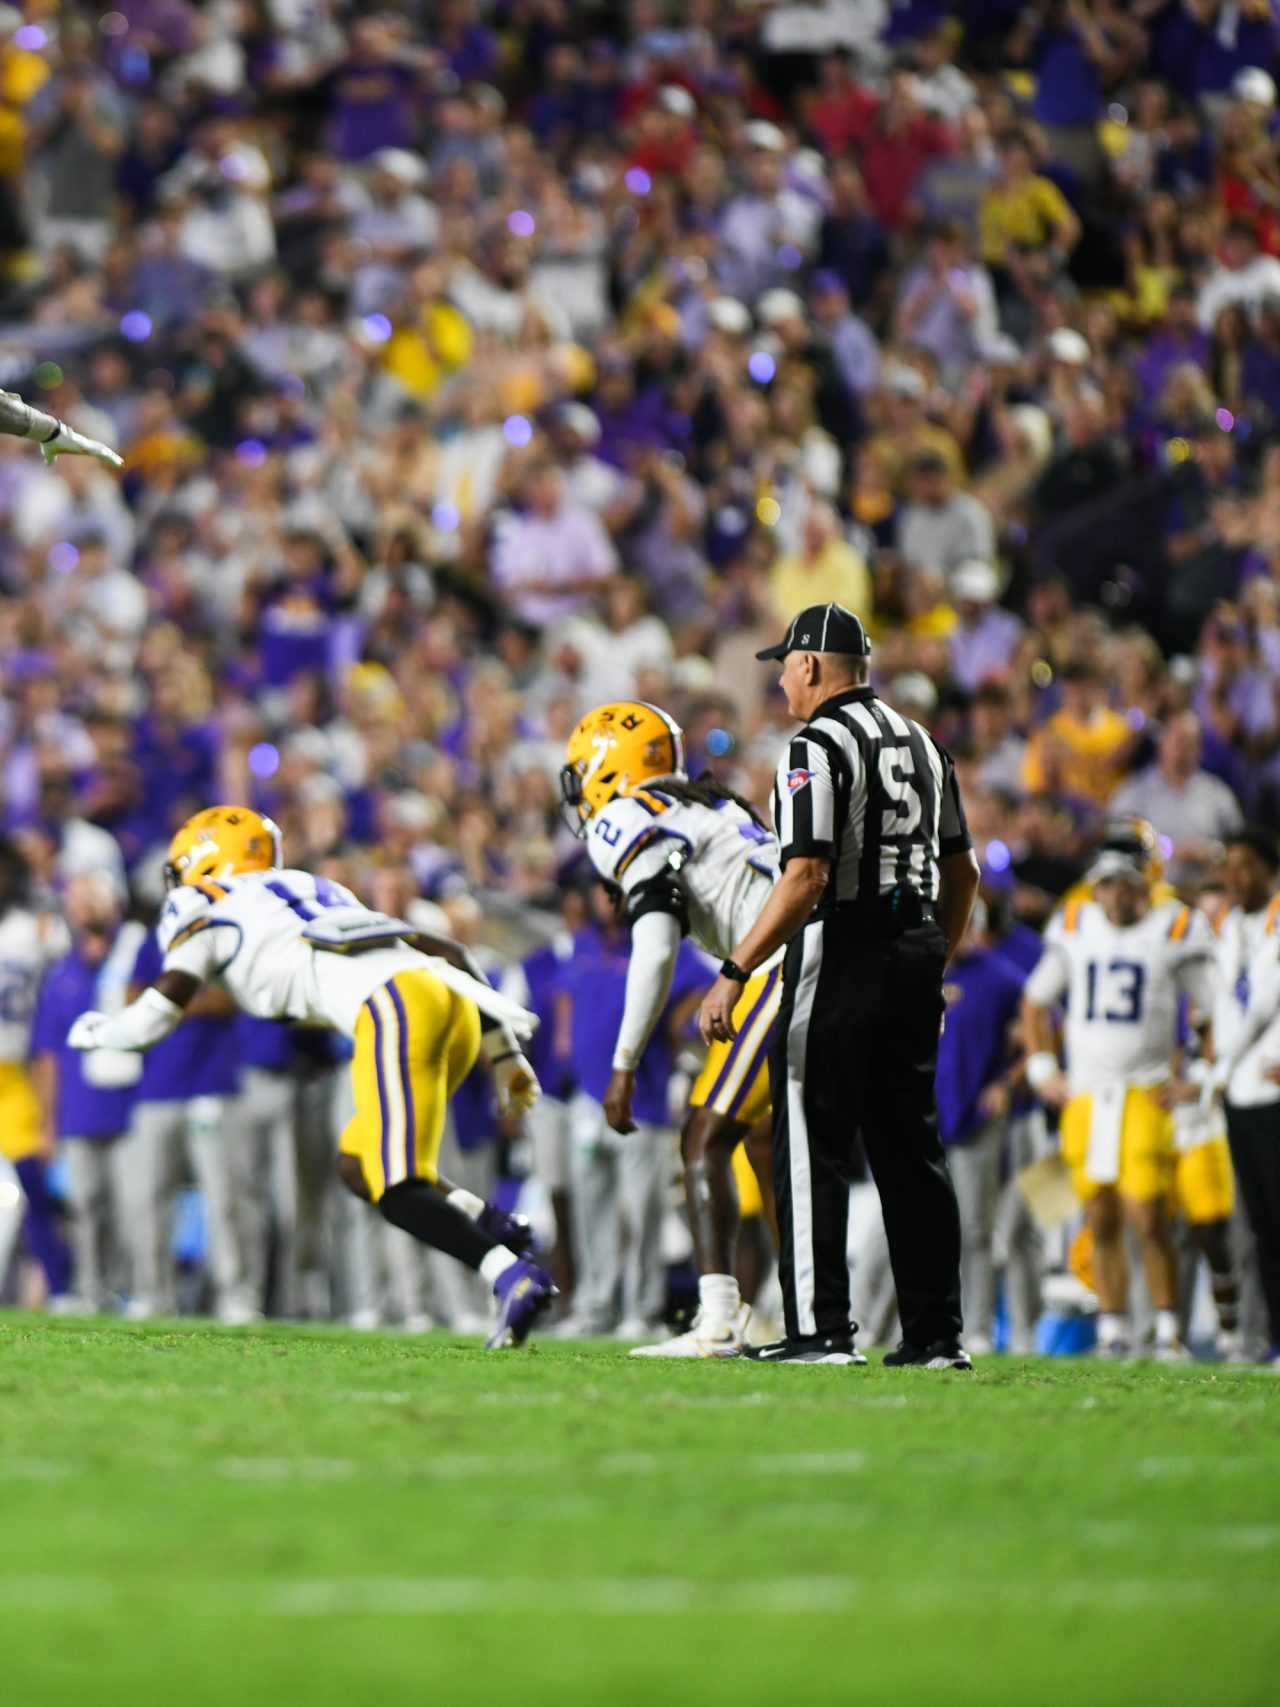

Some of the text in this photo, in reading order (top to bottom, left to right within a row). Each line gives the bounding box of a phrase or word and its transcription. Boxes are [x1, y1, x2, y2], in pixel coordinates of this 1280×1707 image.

[878, 746, 921, 826] S
[595, 818, 622, 847] 2
[1086, 961, 1144, 1021] 13
